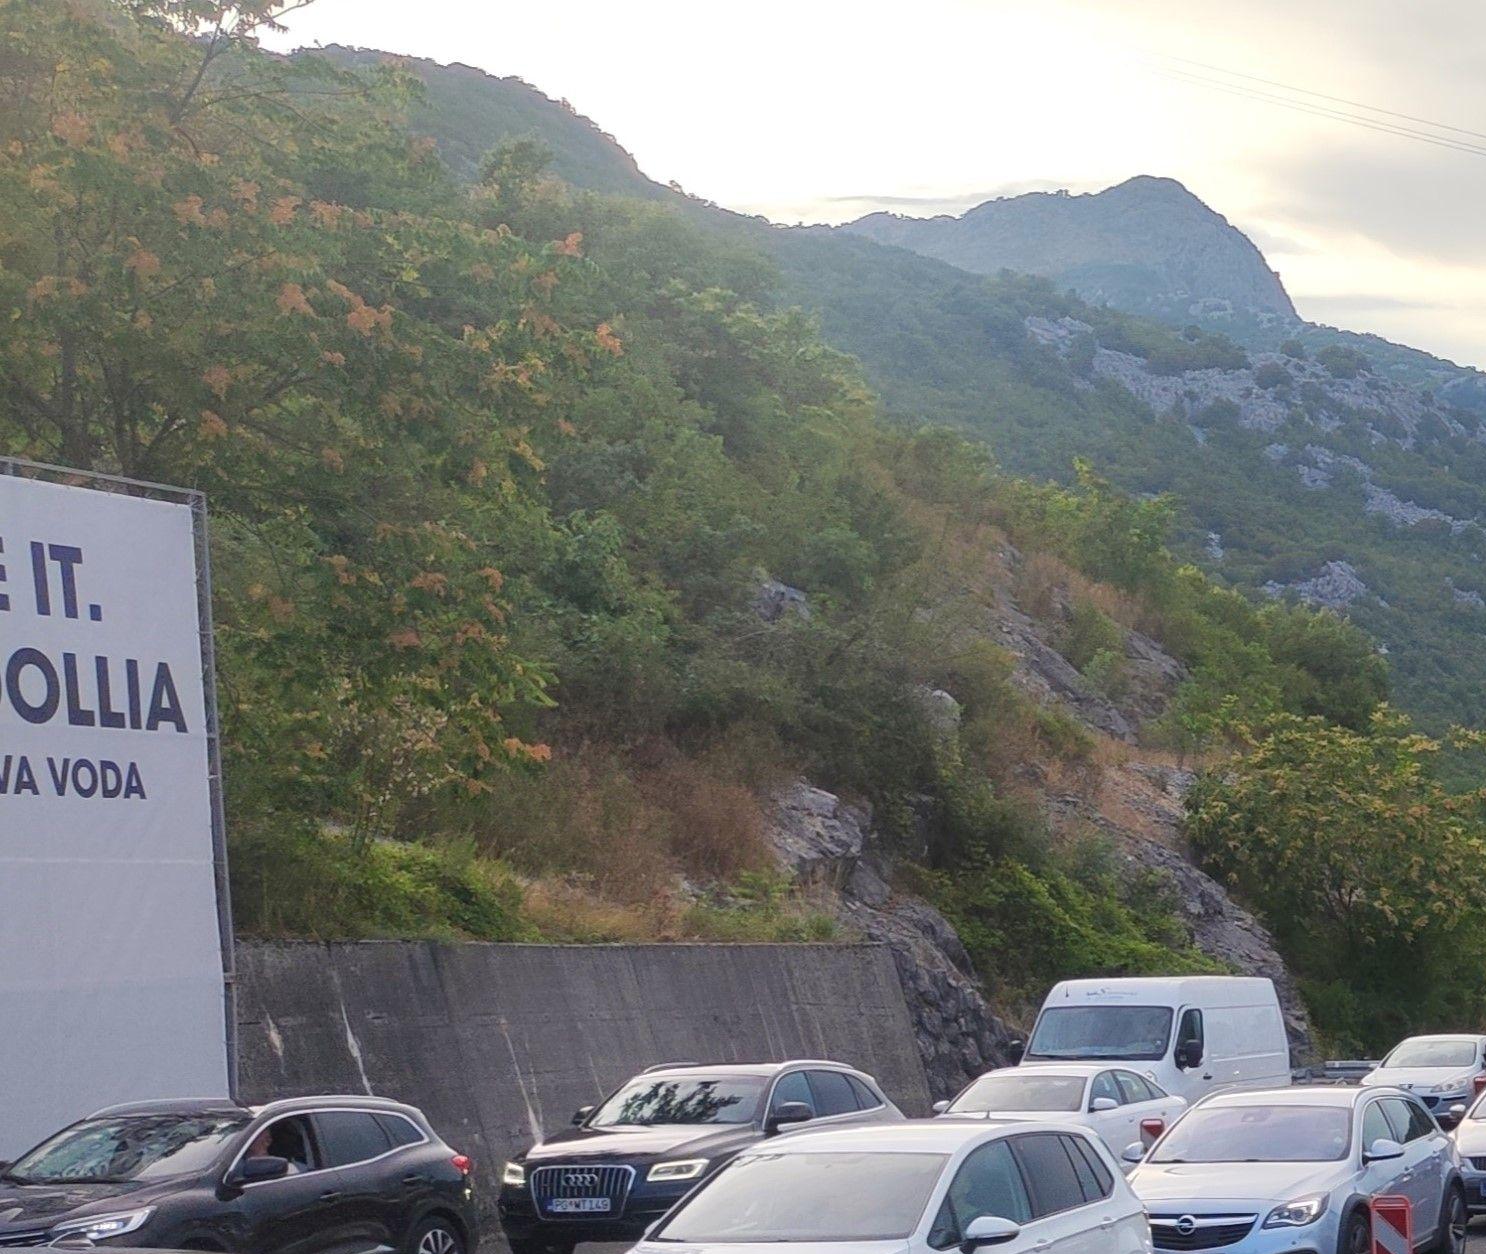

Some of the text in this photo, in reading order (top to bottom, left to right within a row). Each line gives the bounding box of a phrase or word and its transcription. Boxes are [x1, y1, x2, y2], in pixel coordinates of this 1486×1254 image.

[30, 540, 103, 622] IT.
[0, 647, 189, 734] OLLIA
[47, 755, 147, 800] VODA
